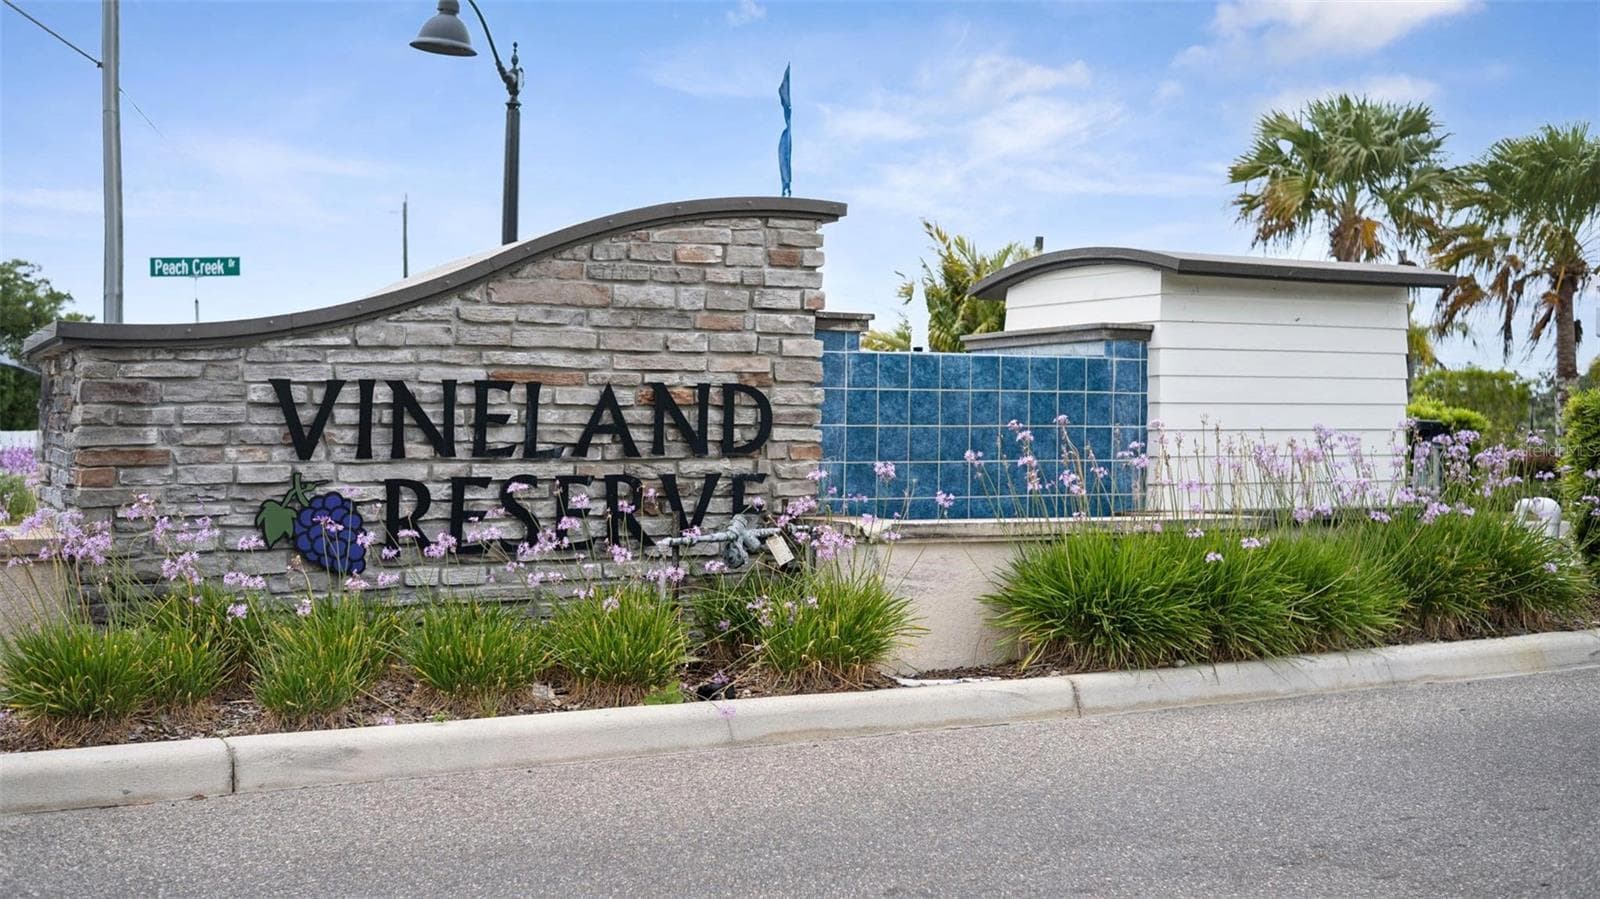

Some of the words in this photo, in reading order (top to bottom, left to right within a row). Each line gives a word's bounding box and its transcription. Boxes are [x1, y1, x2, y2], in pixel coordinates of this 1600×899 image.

[155, 259, 189, 275] Peach
[192, 258, 225, 275] Creek
[227, 258, 236, 268] Dr
[268, 378, 773, 460] VINELAND
